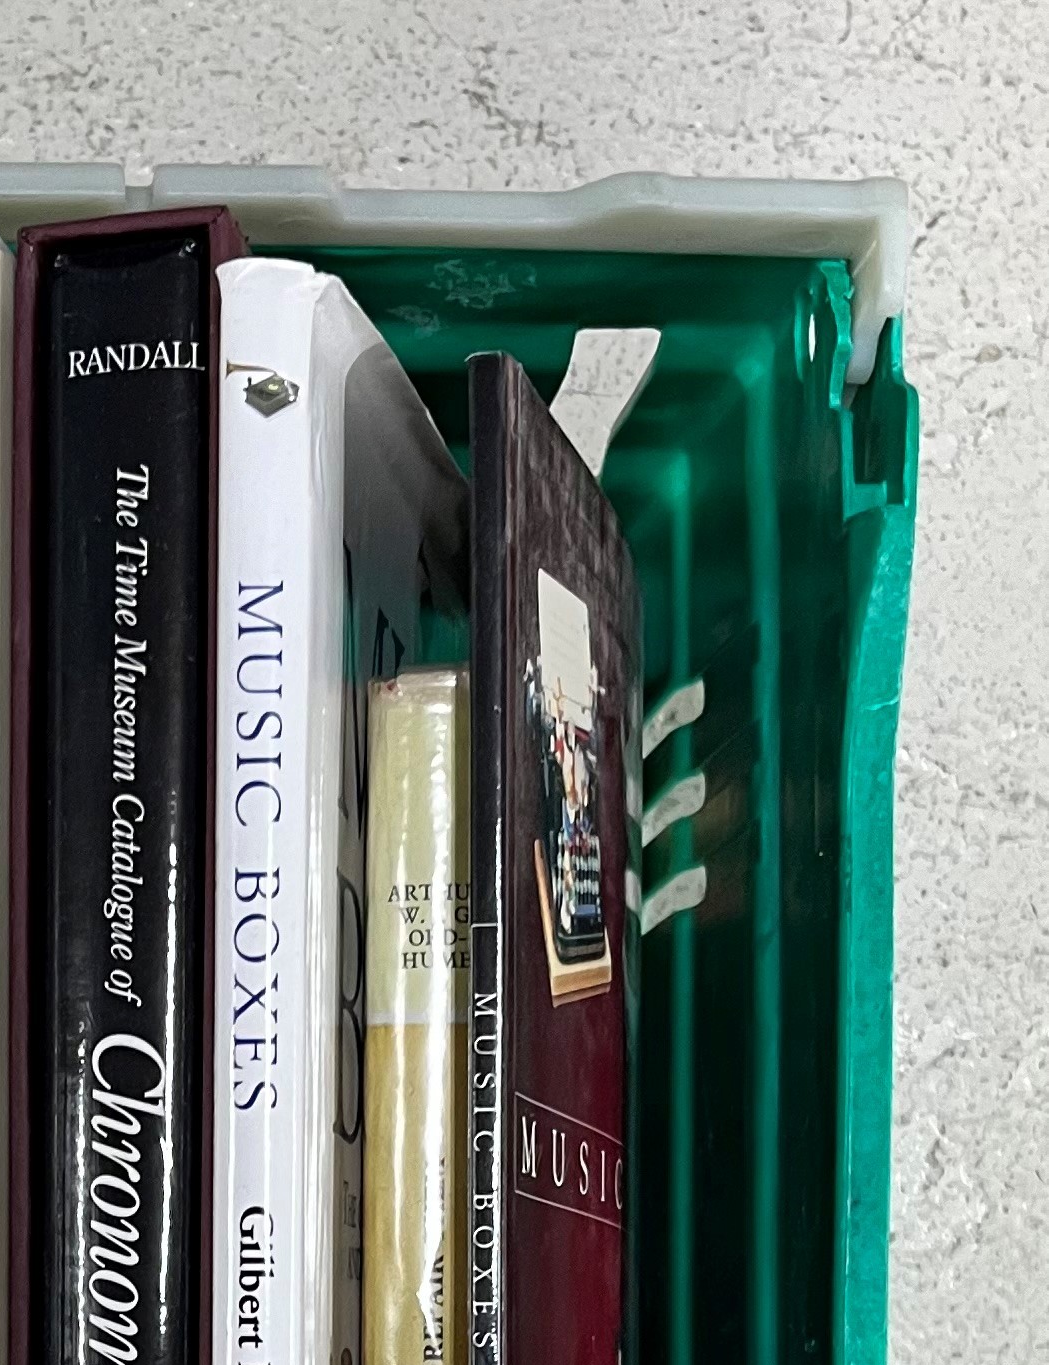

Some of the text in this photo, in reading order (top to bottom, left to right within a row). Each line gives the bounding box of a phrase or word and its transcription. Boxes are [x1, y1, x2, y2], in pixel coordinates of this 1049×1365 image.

[67, 340, 206, 378] RANDALL
[103, 463, 150, 1008] The Time Museum Catalogue of
[234, 580, 285, 829] MUSIC
[232, 868, 282, 1113] BOXES
[236, 1205, 276, 1353] Gilbert
[473, 1193, 496, 1349] BOXES
